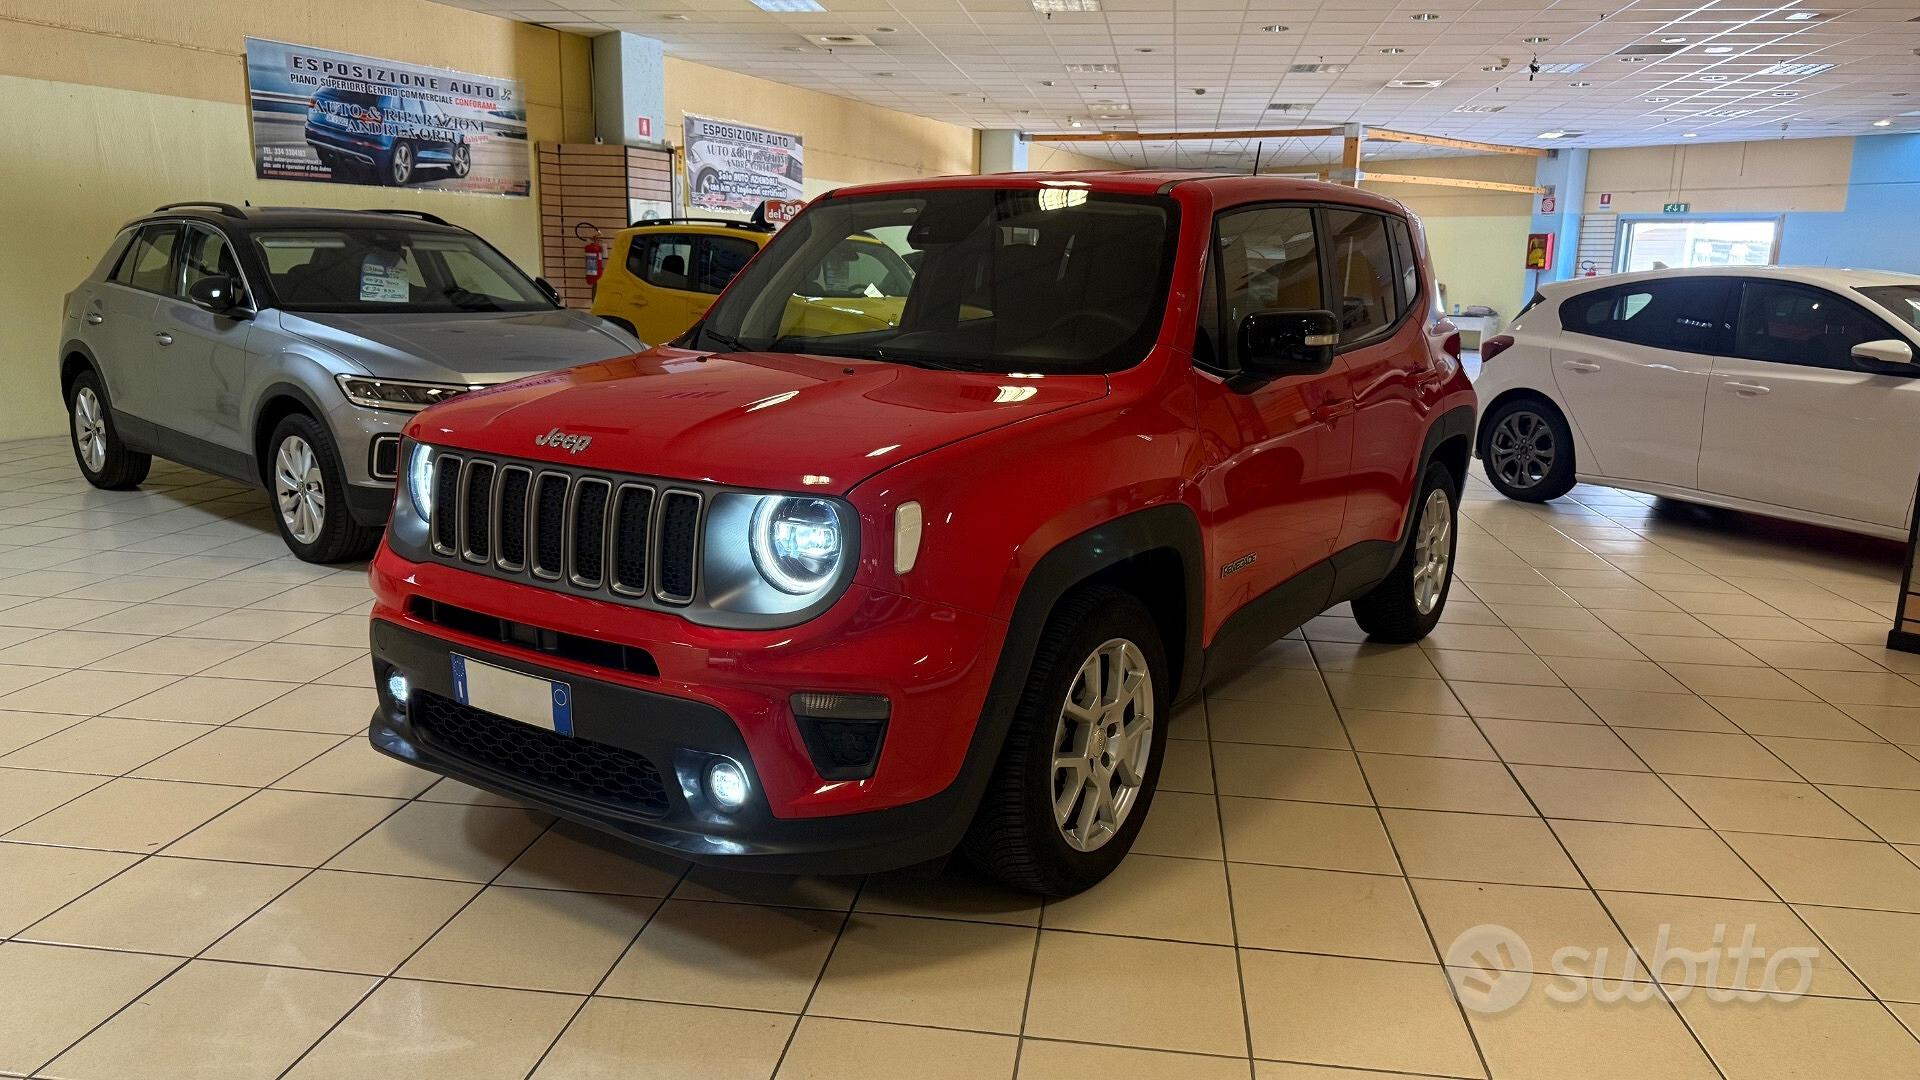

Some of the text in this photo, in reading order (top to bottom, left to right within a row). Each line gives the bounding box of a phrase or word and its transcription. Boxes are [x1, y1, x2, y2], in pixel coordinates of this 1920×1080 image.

[293, 56, 494, 98] ESPOSIZIONE AUTO
[290, 73, 497, 110] PIANO SUPERIORE CENTRO COMMERCIALE CONFORAMA
[312, 99, 362, 119] AUTO
[367, 106, 382, 121] &
[703, 123, 763, 144] ESPOSIZIONE
[766, 134, 788, 148] AUTO
[706, 144, 729, 156] AUTO
[718, 170, 733, 181] Solo
[732, 172, 749, 183] AUTO
[768, 208, 781, 219] del
[536, 427, 592, 455] Jeep
